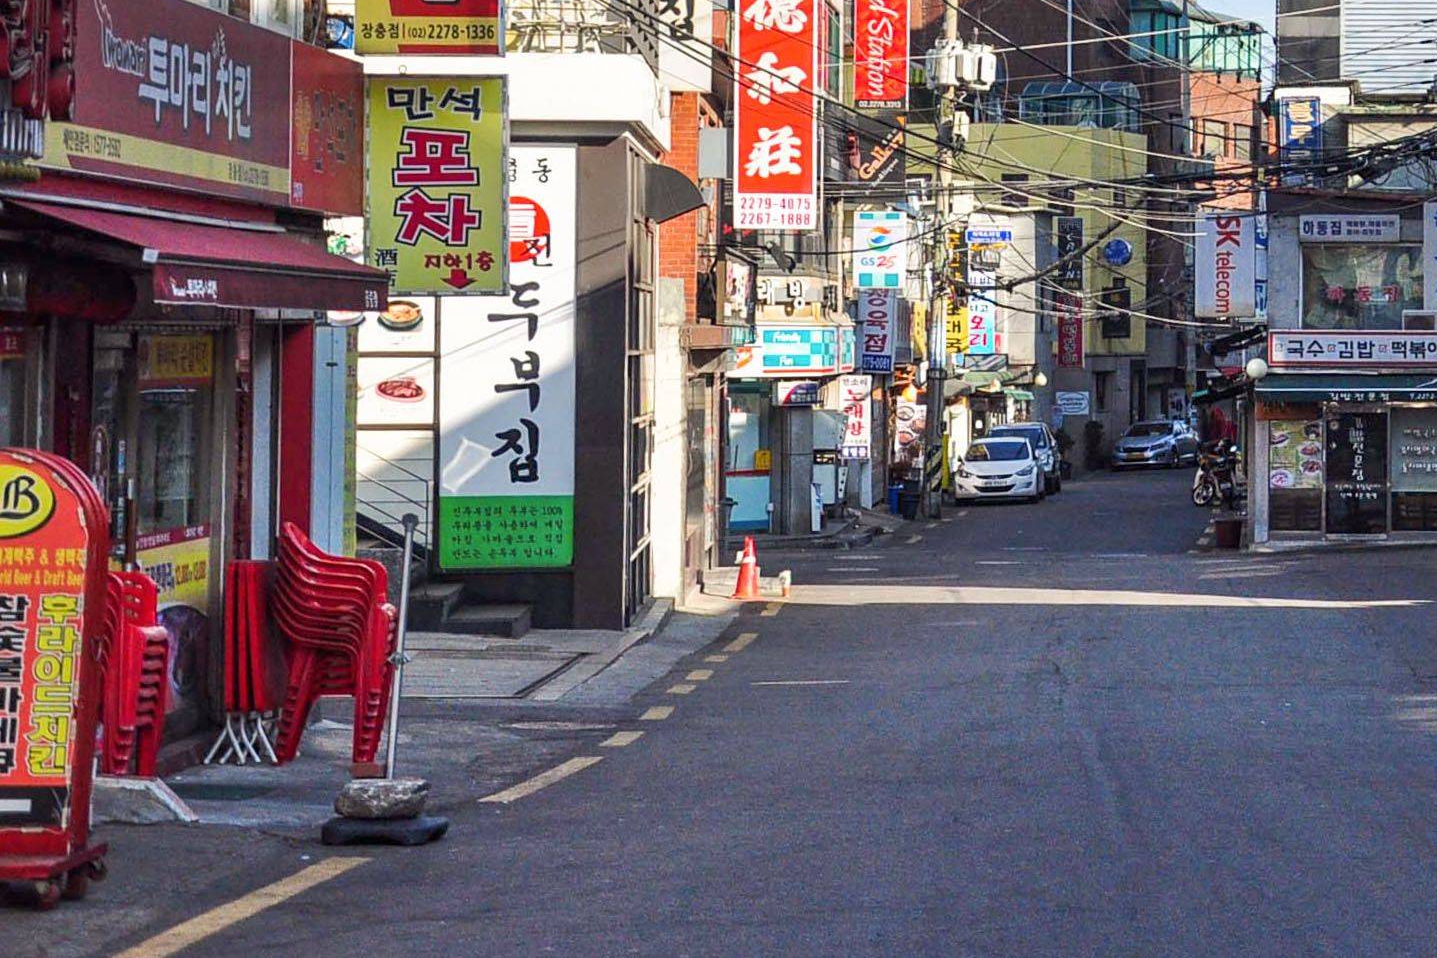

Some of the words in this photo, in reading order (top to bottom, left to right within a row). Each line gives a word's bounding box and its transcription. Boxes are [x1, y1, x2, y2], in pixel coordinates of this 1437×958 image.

[361, 22, 400, 40] 장충점
[407, 23, 495, 41] (02)2278-1336
[867, 13, 895, 98] Station
[138, 36, 211, 135] 투마리
[215, 56, 252, 142] 치킨
[387, 86, 482, 122] 만석
[391, 125, 482, 248] 포차
[740, 212, 811, 226] 2267-1888
[1216, 216, 1242, 248] SK
[424, 250, 495, 272] 지하1층
[860, 254, 898, 269] GS25
[1215, 251, 1238, 314] telecom
[1286, 340, 1325, 359] 국수
[1338, 340, 1376, 359] 김밥
[488, 282, 541, 484] 두부집
[29, 593, 82, 777] 후라이드치킨
